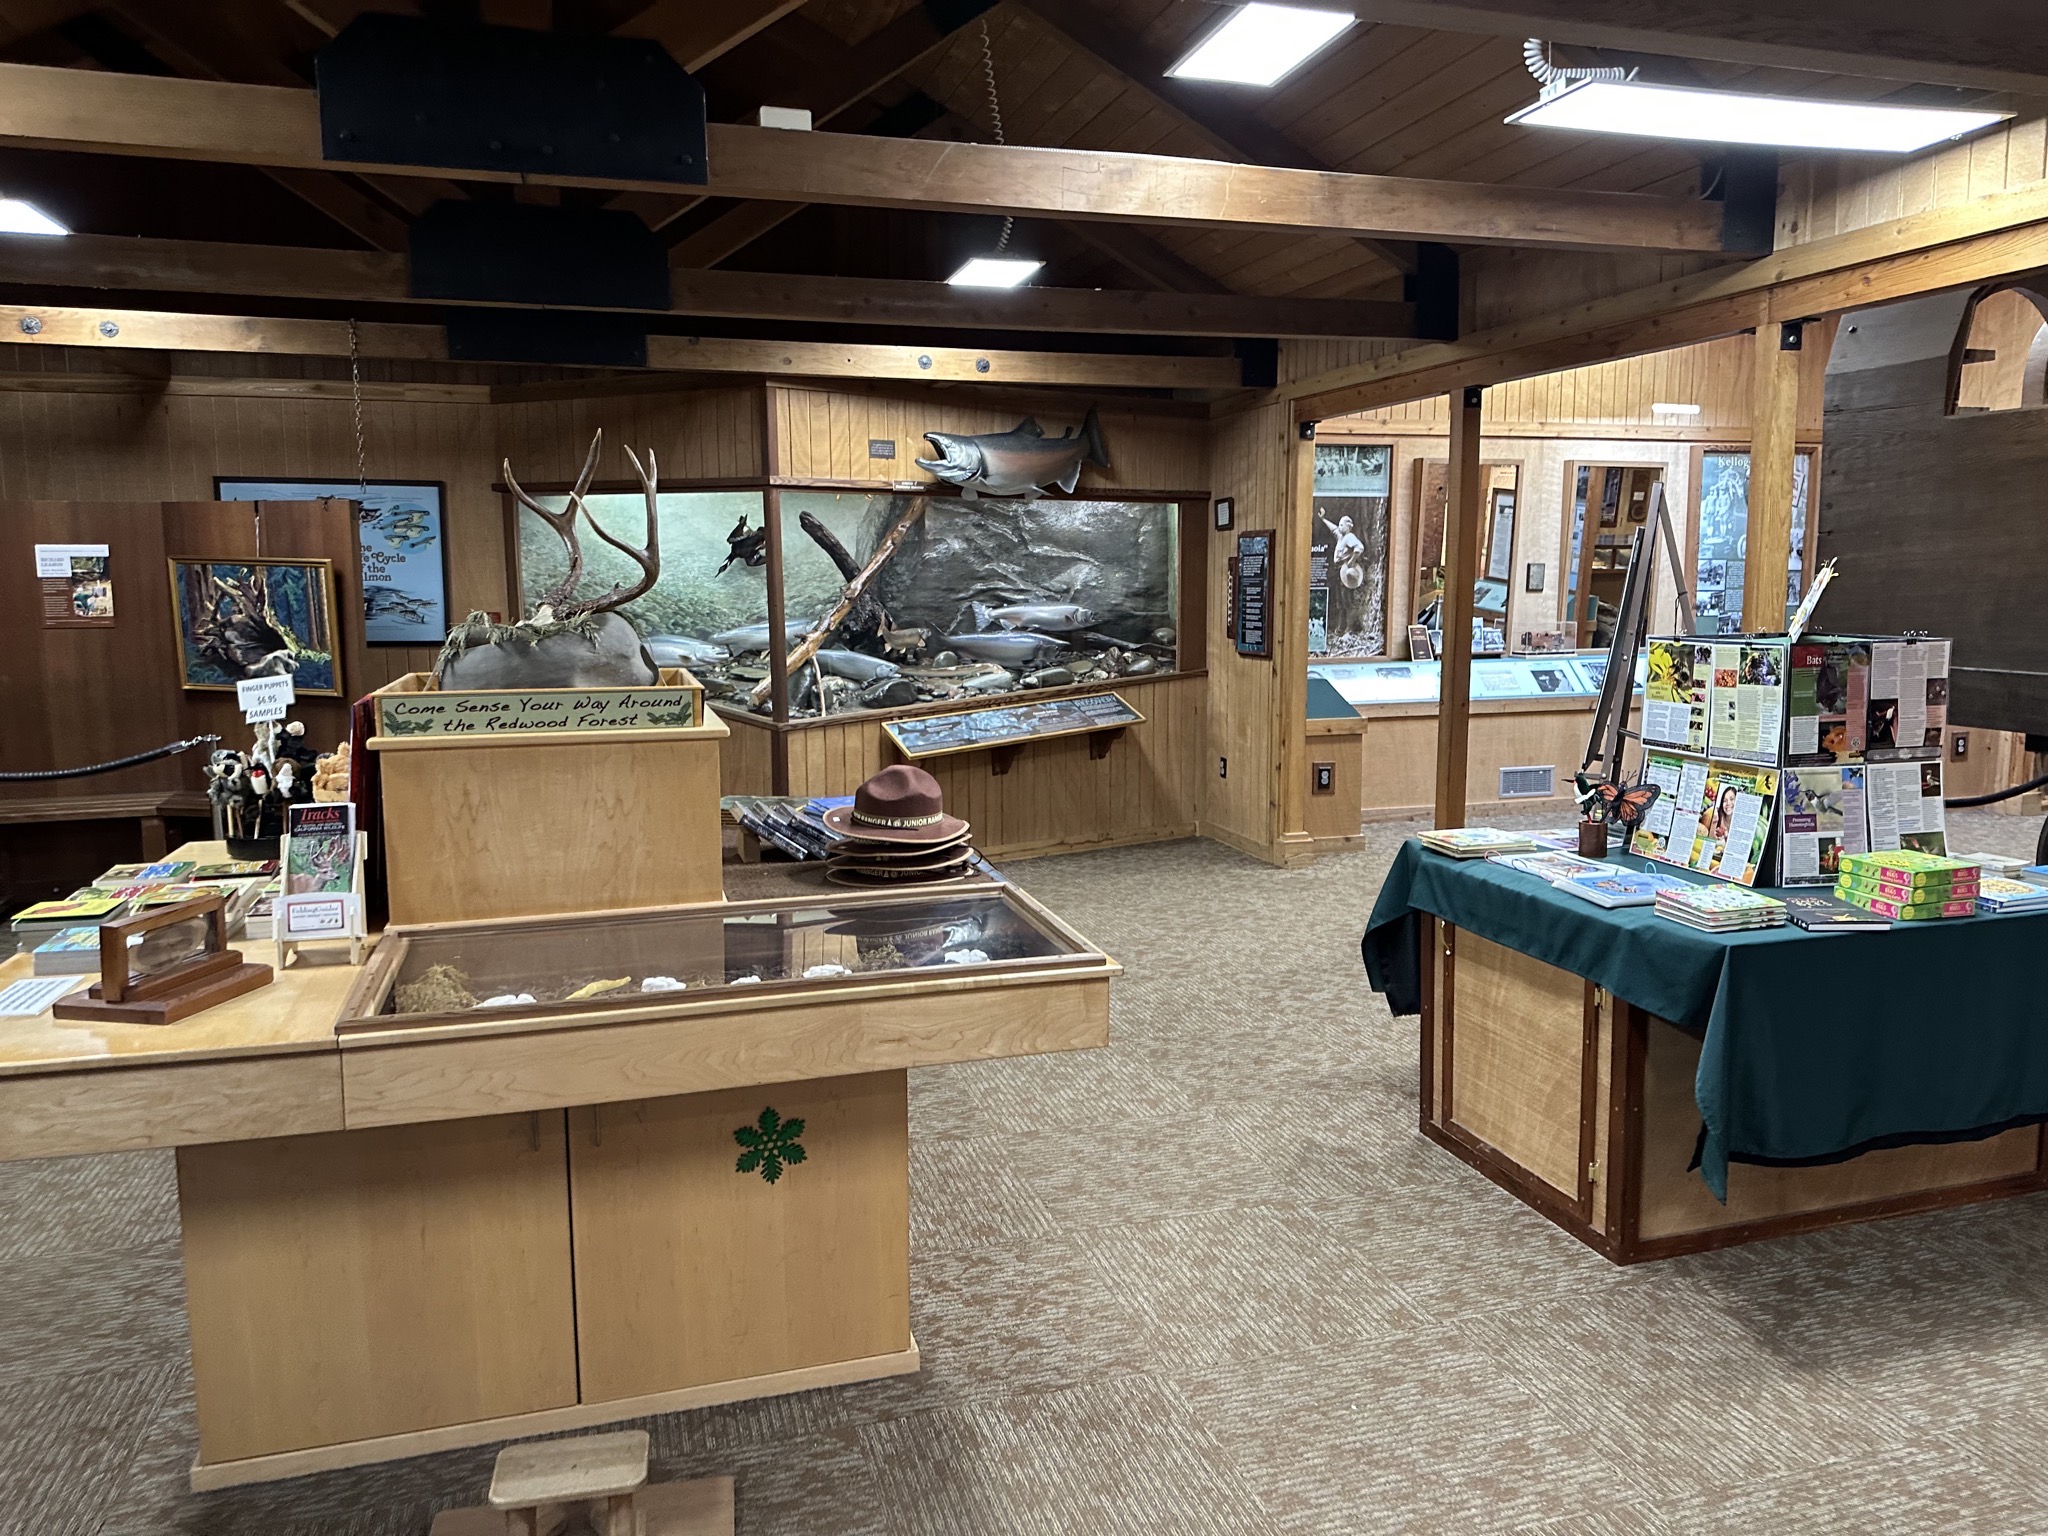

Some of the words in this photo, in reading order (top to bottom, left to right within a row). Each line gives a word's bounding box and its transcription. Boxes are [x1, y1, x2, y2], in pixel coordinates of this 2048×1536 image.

[1718, 456, 1750, 470] Kellog
[371, 551, 406, 565] Cycle
[367, 562, 386, 573] the
[364, 572, 392, 581] lmon
[1806, 655, 1823, 665] Bats
[242, 685, 264, 693] FINGER
[264, 680, 289, 690] PUPPETS
[257, 694, 278, 705] $6.95
[394, 702, 447, 715] Come
[455, 700, 511, 713] Sense
[519, 697, 564, 712] Your
[573, 696, 610, 713] Way
[618, 694, 683, 708] Around
[249, 706, 283, 719] SAMPLES
[443, 718, 476, 732] the
[485, 716, 569, 731] Redwood
[576, 713, 639, 727] Forest
[301, 807, 341, 820] Tracks
[902, 818, 927, 828] JUNIOR
